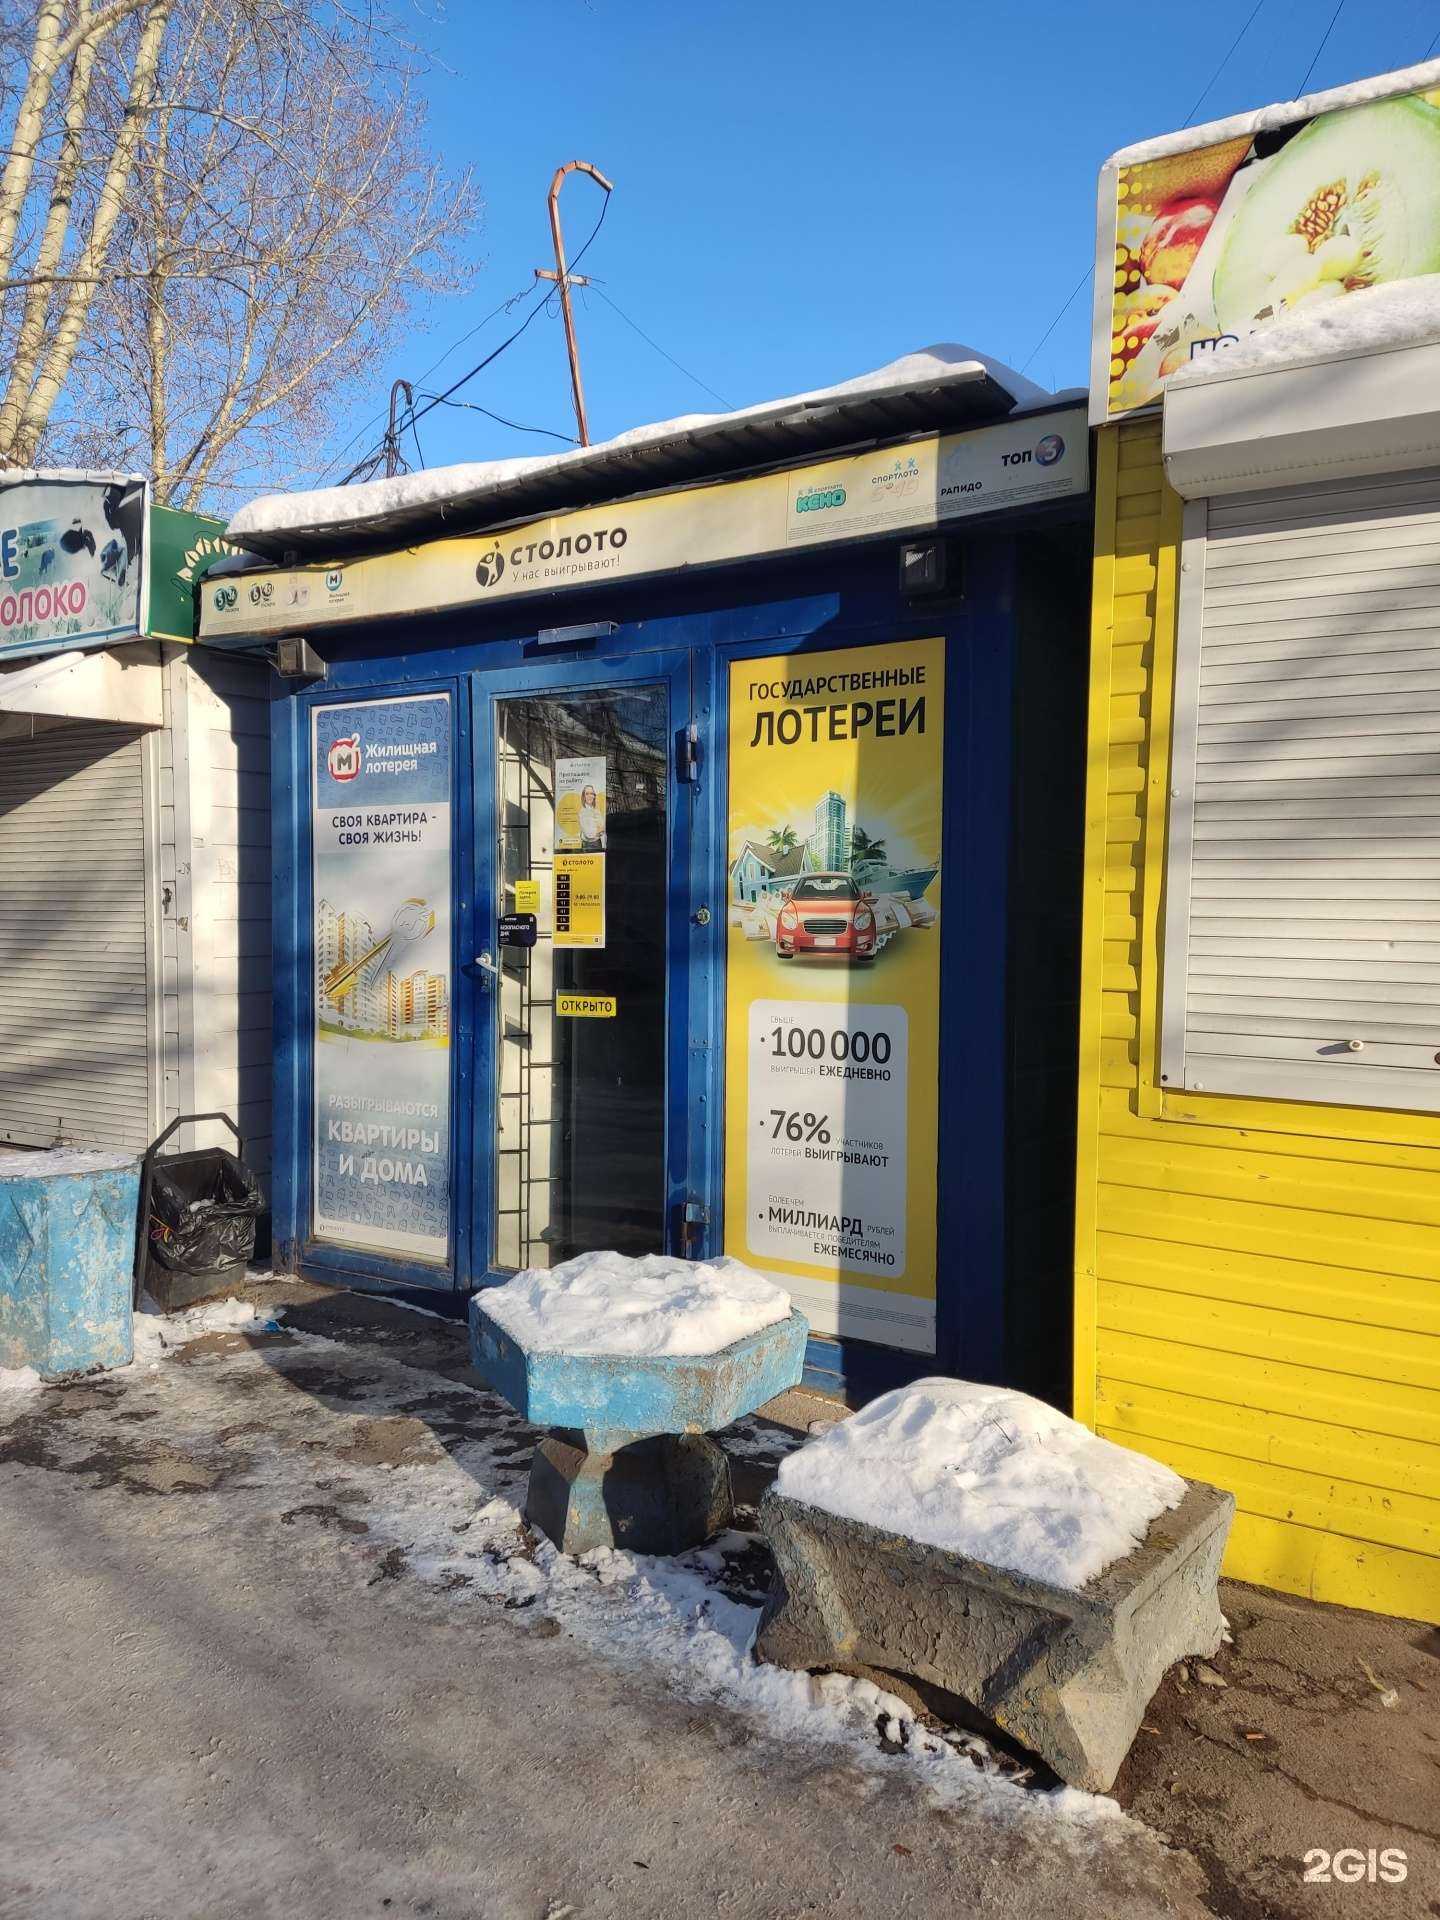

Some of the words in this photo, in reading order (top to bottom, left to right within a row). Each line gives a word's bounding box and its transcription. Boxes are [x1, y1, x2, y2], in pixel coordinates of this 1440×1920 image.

[1001, 450, 1032, 467] ТОП
[940, 481, 983, 496] РАПИДО
[0, 530, 19, 577] Е
[510, 527, 628, 566] СТОЛОТО
[513, 571, 519, 583] У
[522, 569, 540, 581] нас
[544, 554, 621, 577] выигрывают!
[0, 582, 86, 627] ОЛОКО
[749, 666, 926, 700] ГОСУДАРСТВЕННЫЕ
[750, 696, 926, 747] ЛОТЕРЕИ
[365, 741, 437, 759] Жилищная
[365, 759, 418, 775] лотерея
[332, 815, 362, 828] СВОЯ
[366, 812, 428, 826] КВАРТИРА
[338, 832, 369, 845] СВОЯ
[373, 830, 422, 844] ЖИЗНЬ!
[561, 1000, 612, 1012] ОТКРЫТО
[770, 1015, 795, 1024] СВЫШЕ
[770, 1065, 816, 1076] ВЫИГРЫШЕЙ
[819, 1065, 891, 1081] ЕЖЕДНЕВНО
[328, 1095, 439, 1118] РАЗЫГРЫВАЮТСЯ
[328, 1119, 439, 1154] КВАРТИРЫ
[770, 1109, 831, 1145] 76%
[836, 1137, 884, 1150] УЧАСТНИКОВ
[804, 1147, 889, 1168] ВЫИГРЫВАЮТ
[339, 1153, 354, 1176] И
[360, 1156, 428, 1186] ДОМА
[768, 1206, 863, 1237] МИЛЛИАРД
[867, 1225, 895, 1237] РУБЛЕЙ
[827, 1234, 880, 1248] ПОБЕДИТЕЛЯМ
[813, 1242, 895, 1266] ЕЖЕМЕСЯЧНО
